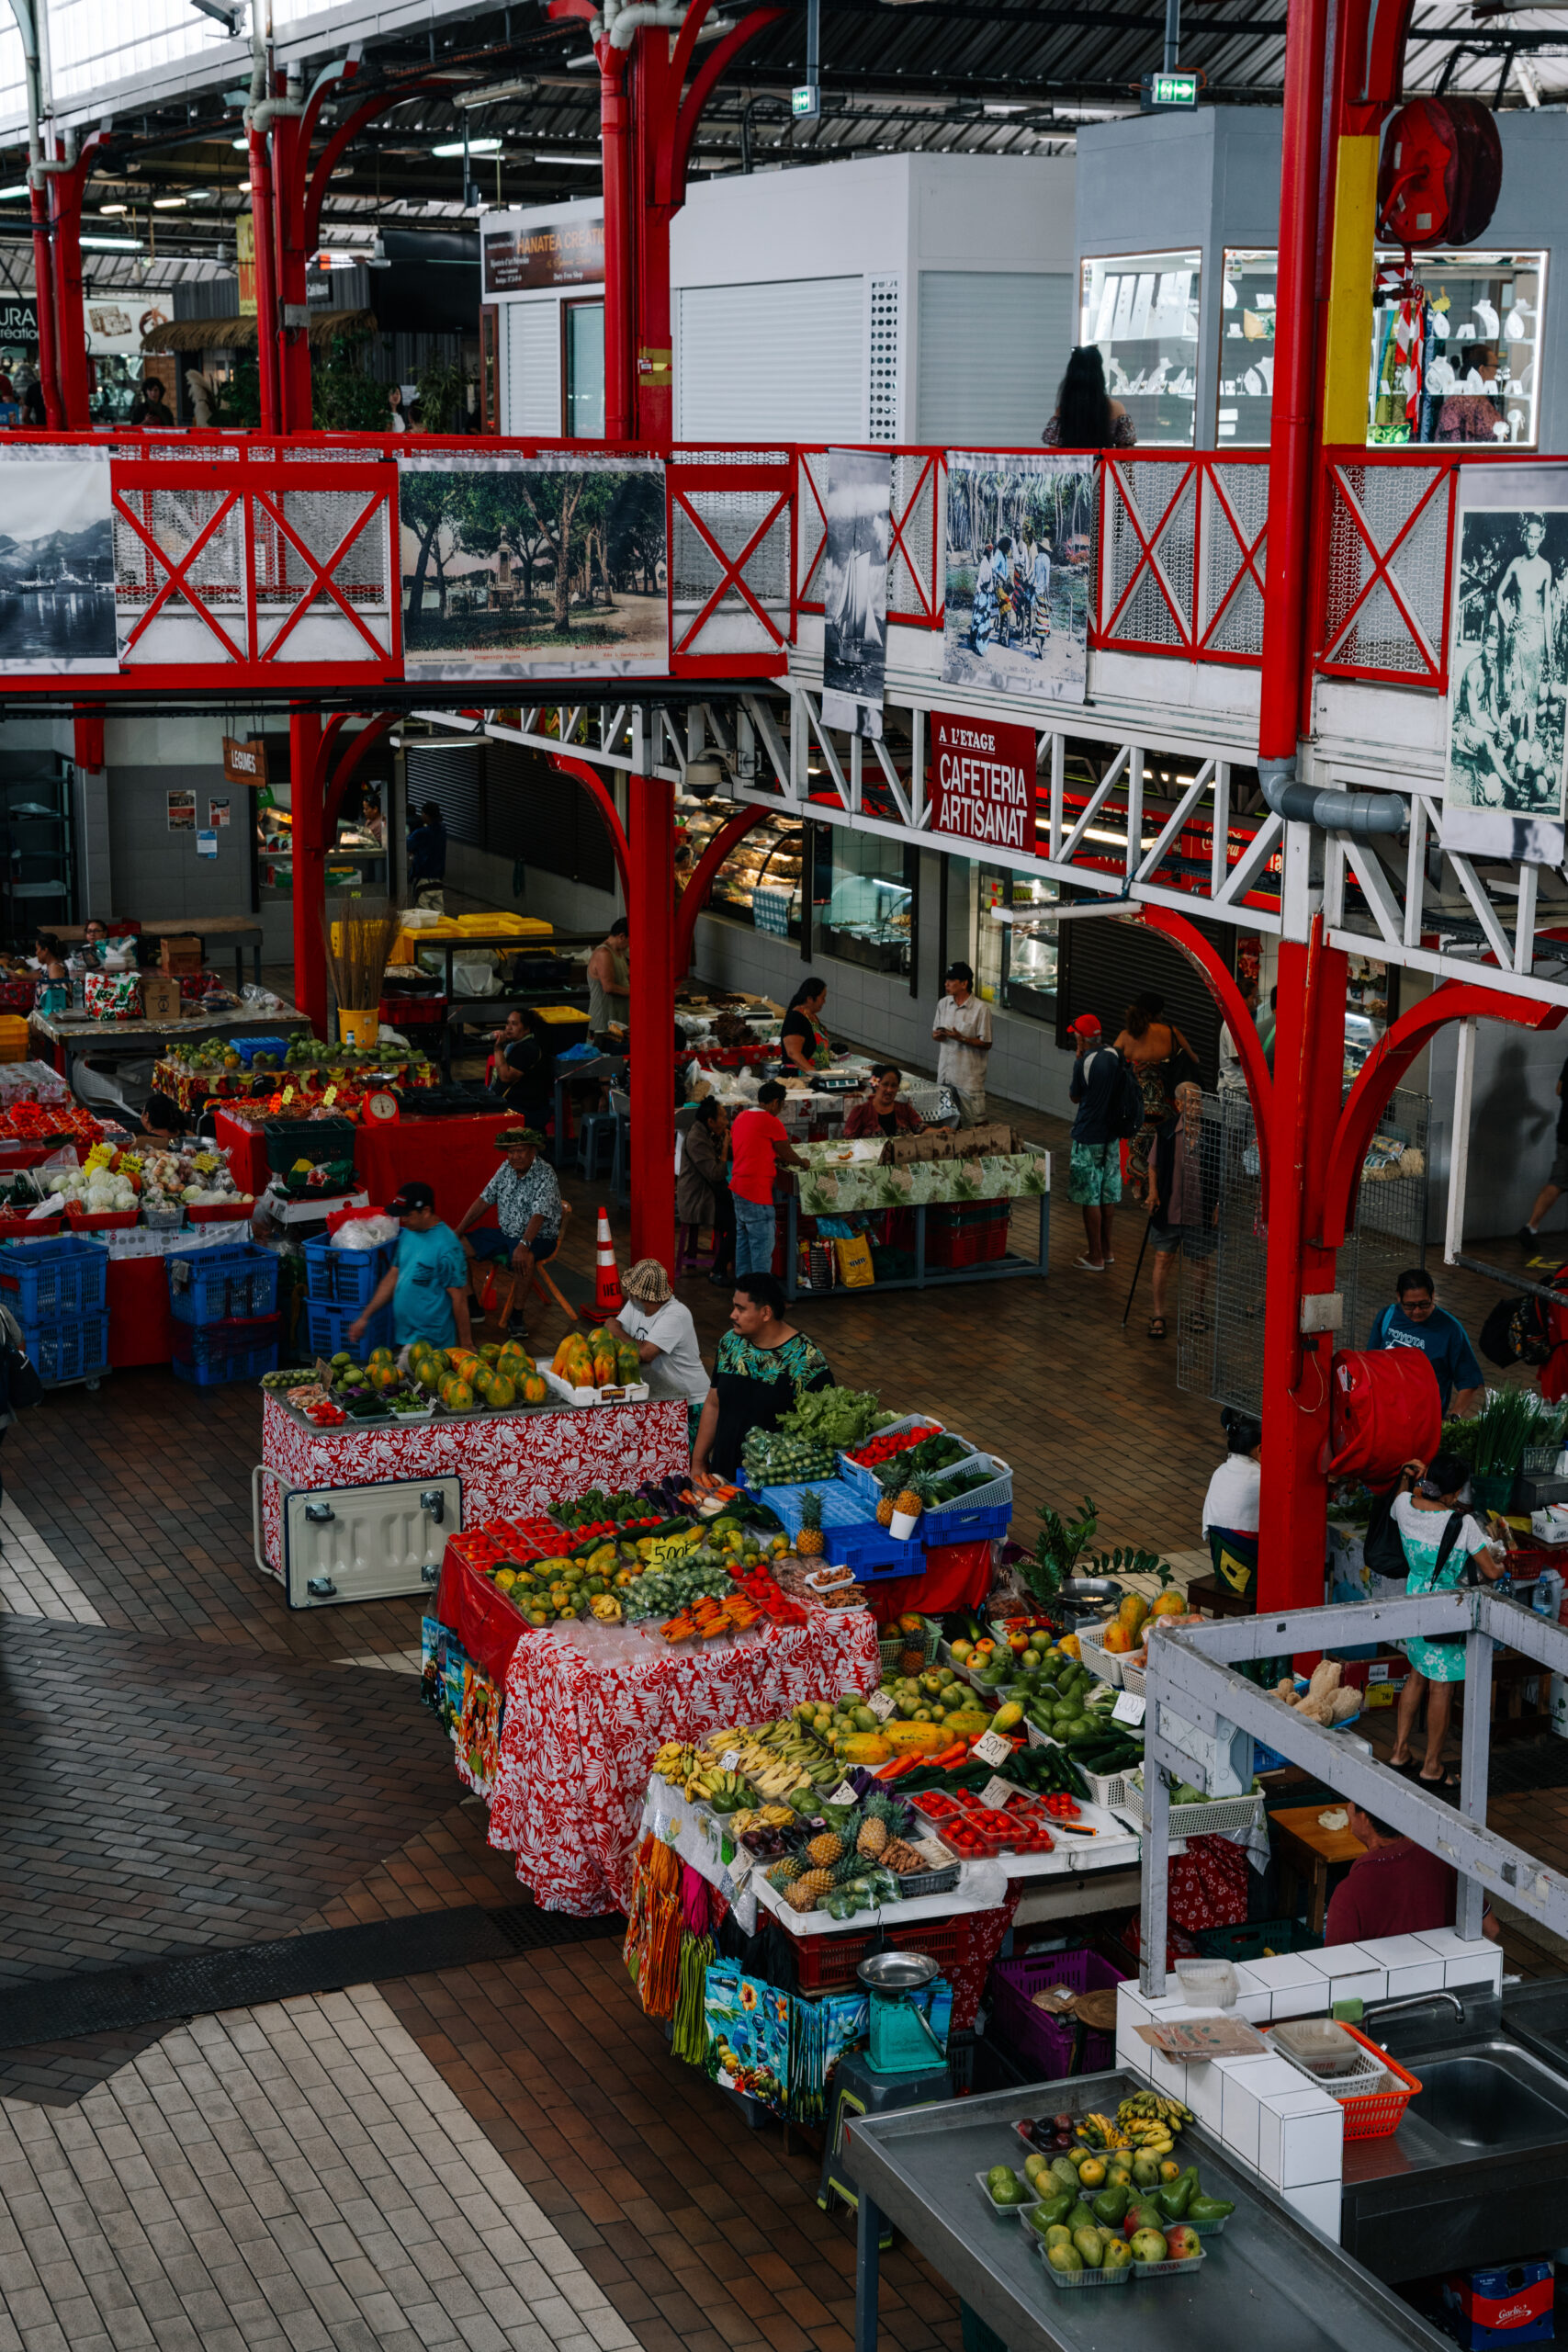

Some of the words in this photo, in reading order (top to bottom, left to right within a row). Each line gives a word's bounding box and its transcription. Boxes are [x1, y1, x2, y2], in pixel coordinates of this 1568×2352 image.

[516, 234, 563, 255] HANATEA
[938, 725, 948, 743] A
[951, 728, 996, 752] L'ETAGE
[231, 749, 256, 775] LEGUMES
[939, 752, 1028, 808] CAFETERIA
[939, 792, 1027, 847] ARTISANAT
[1388, 1328, 1425, 1350] TOYOTA
